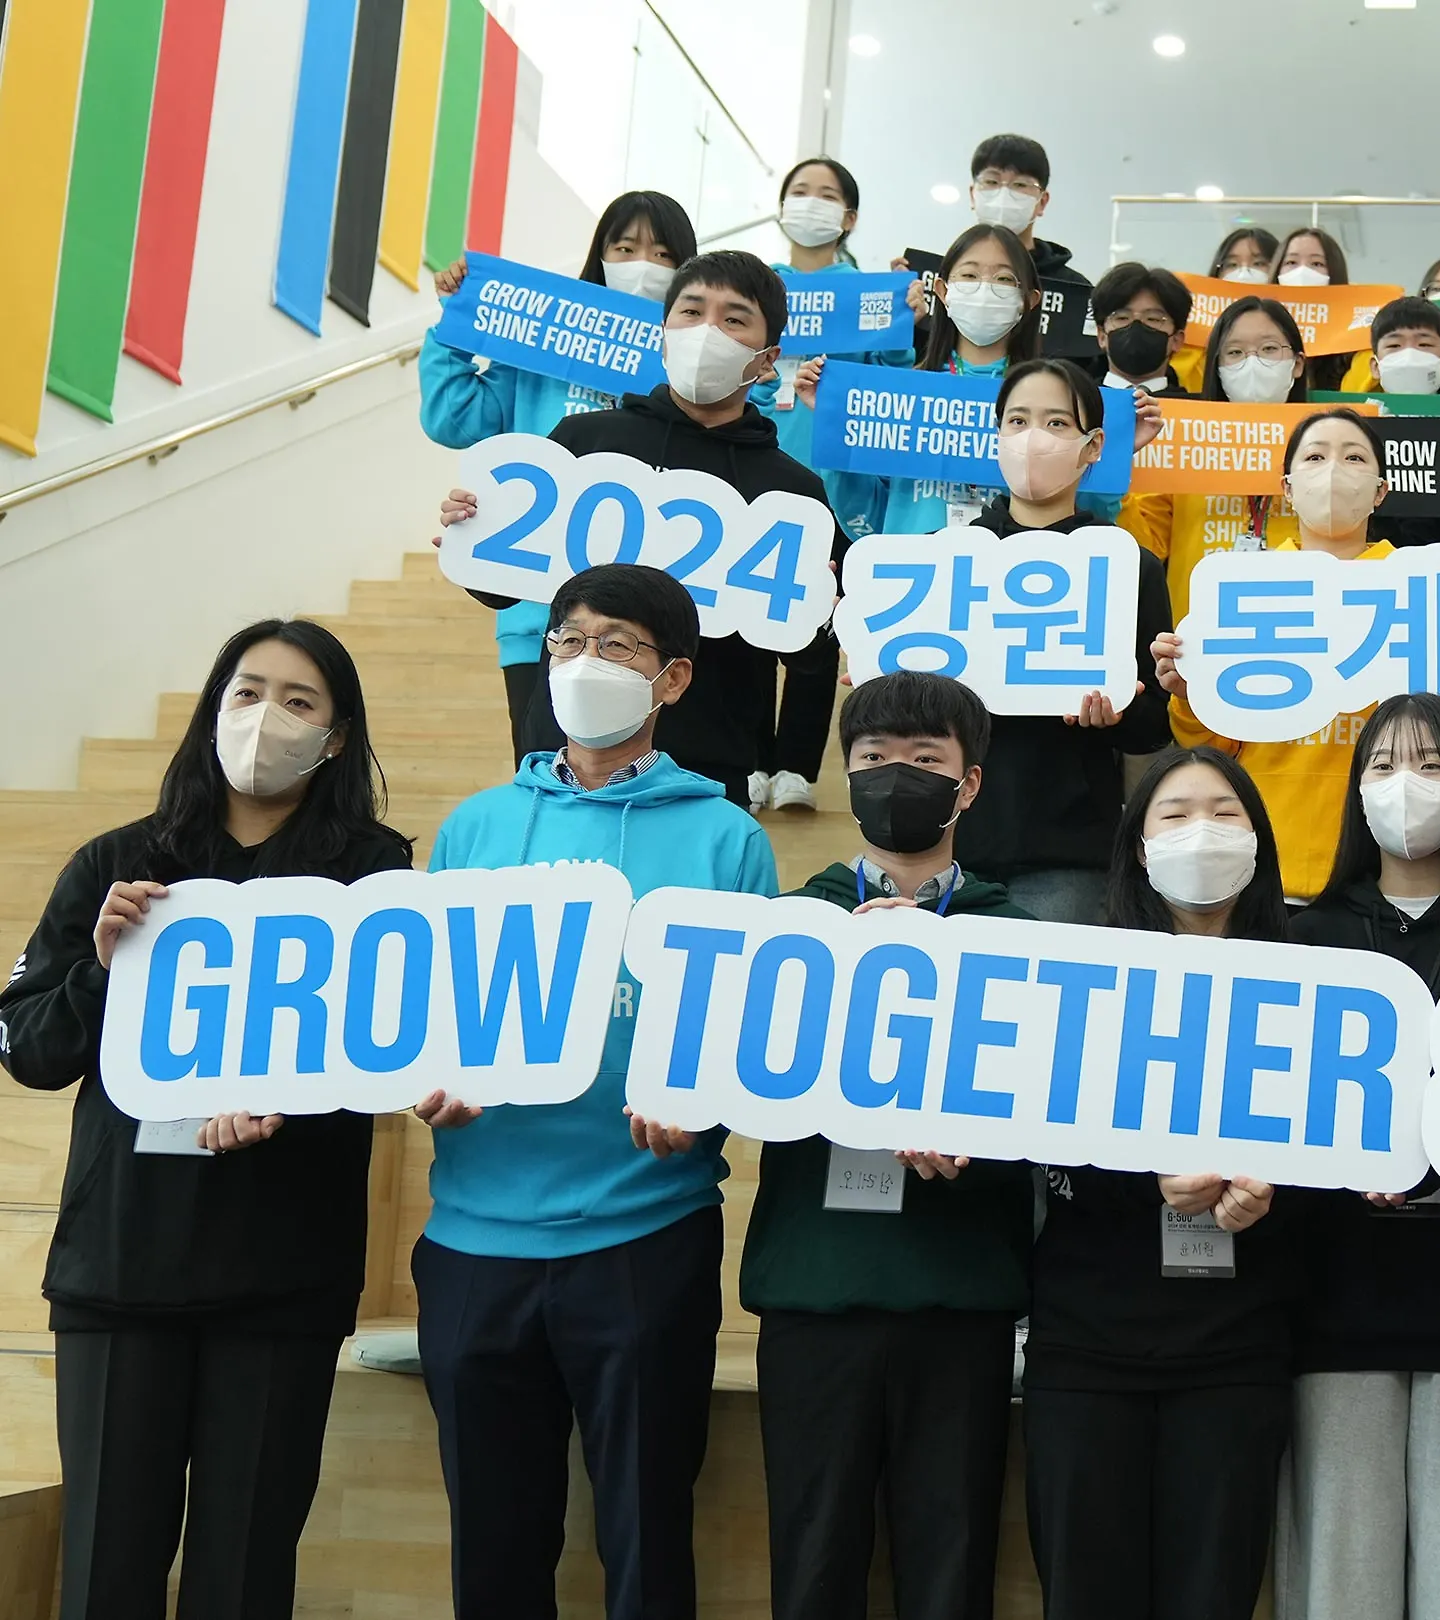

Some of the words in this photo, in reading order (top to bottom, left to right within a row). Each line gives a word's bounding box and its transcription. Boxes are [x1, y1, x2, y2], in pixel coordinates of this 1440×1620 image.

[479, 279, 554, 318] GROW
[552, 298, 663, 352] TOGETHER
[786, 291, 835, 313] THER
[860, 301, 893, 314] 2024
[473, 305, 540, 347] SHINE
[541, 326, 642, 376] FOREVER
[847, 388, 916, 422] GROW
[921, 396, 997, 429] TOGET
[844, 419, 909, 452] SHINE
[915, 426, 998, 460] FOREVE
[1180, 418, 1285, 445] TOGETHER
[1180, 446, 1272, 471] FOREVER
[1384, 440, 1437, 466] ROW
[1386, 469, 1437, 494] HINE
[473, 462, 807, 623] 2024
[864, 556, 1109, 686] 강원
[140, 901, 593, 1082] GROW
[663, 923, 1399, 1152] TOGETHER
